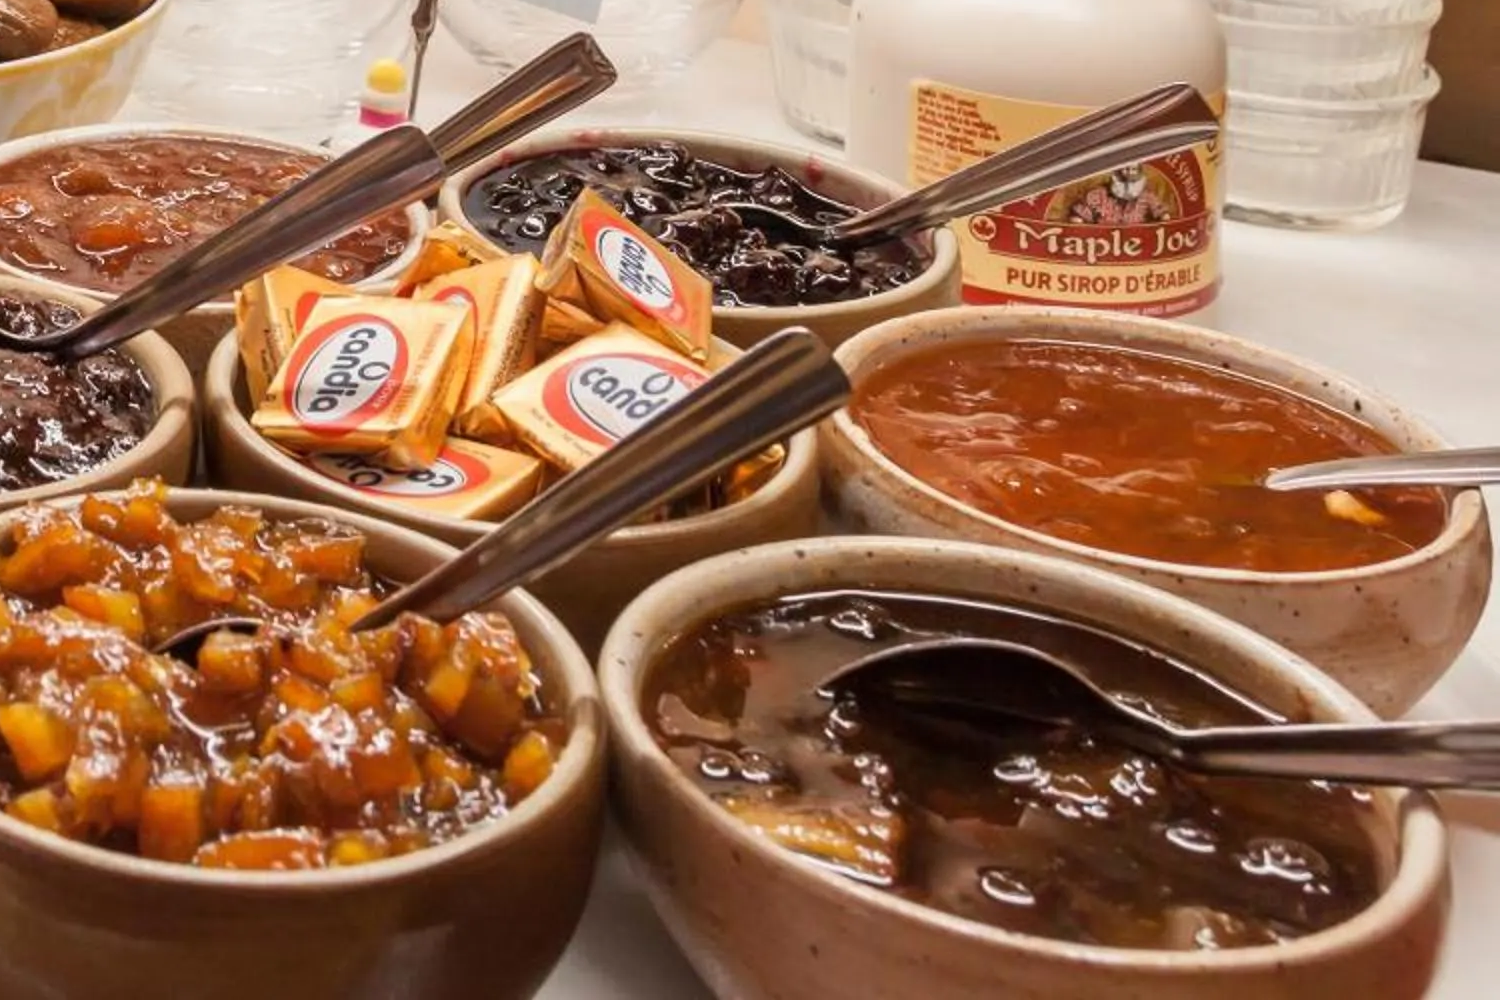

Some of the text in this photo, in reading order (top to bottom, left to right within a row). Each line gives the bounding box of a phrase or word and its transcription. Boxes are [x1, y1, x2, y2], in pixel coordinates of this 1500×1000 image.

[1014, 221, 1199, 265] Maple Joe
[1005, 264, 1202, 295] PUR SIROP D'ÉRABLE
[306, 327, 378, 413] candia
[579, 366, 669, 420] cand
